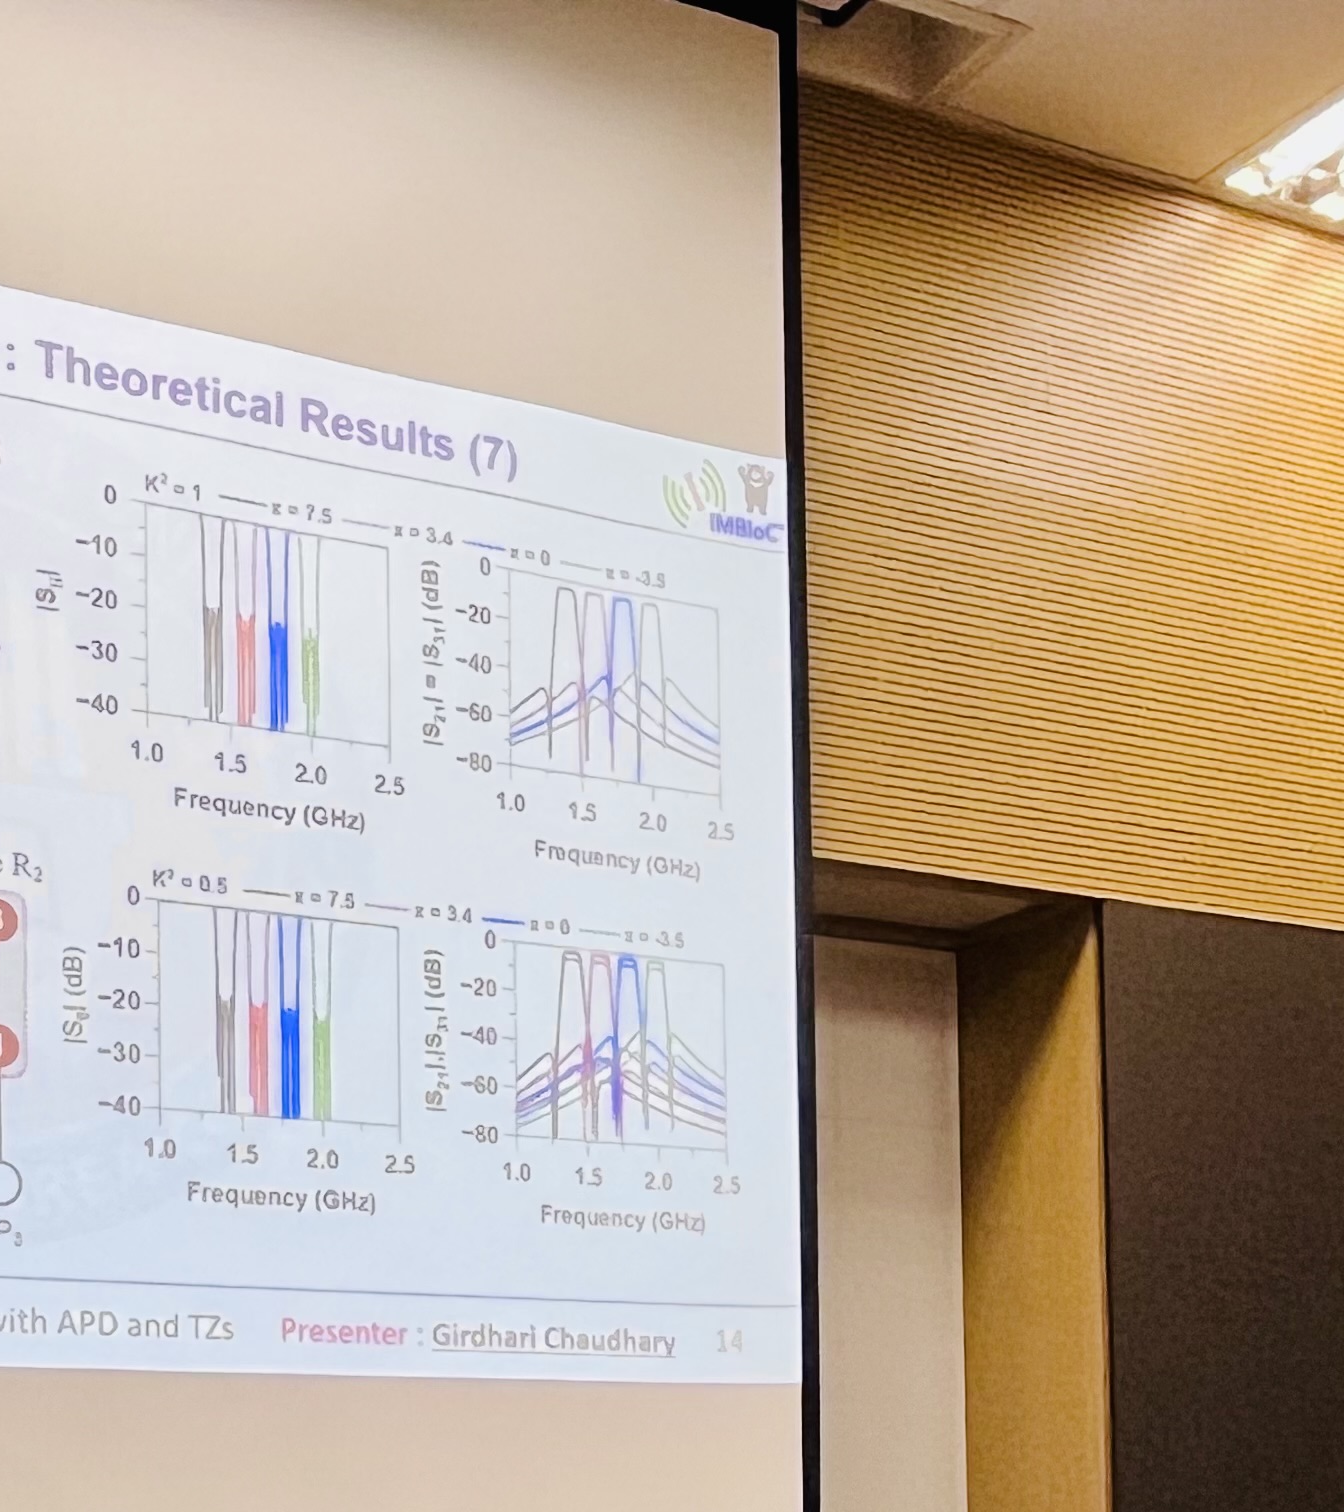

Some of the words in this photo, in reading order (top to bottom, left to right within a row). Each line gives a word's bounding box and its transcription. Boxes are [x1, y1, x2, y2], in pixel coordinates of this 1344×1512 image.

[5, 343, 17, 372] :
[35, 339, 284, 428] Theoretical
[300, 397, 455, 462] Results
[468, 432, 519, 483] (7)
[104, 485, 117, 504] 0
[480, 556, 491, 575] 0
[131, 739, 164, 763] 1.0
[214, 752, 247, 774] 1.5
[294, 763, 328, 786] 2.0
[374, 774, 405, 796] 2.5
[174, 787, 296, 826] Frequency
[303, 804, 366, 834] (GHz)
[496, 791, 526, 812] 1.0
[568, 802, 597, 823] 1.5
[639, 812, 667, 832] 2.0
[708, 821, 735, 842] 2.5
[534, 838, 641, 873] Frequency
[646, 855, 702, 882] (GHz)
[127, 886, 140, 904] 0
[484, 930, 496, 949] 0
[62, 946, 87, 997] (dB)
[423, 948, 446, 1001] (dB)
[144, 1138, 176, 1159] 1.0
[227, 1143, 259, 1165] 1.5
[307, 1149, 339, 1170] 2.0
[384, 1154, 416, 1175] 2.5
[503, 1162, 531, 1182] 1.0
[575, 1168, 602, 1187] 1.5
[644, 1172, 672, 1191] 2.0
[712, 1175, 741, 1195] 2.5
[187, 1181, 307, 1213] Frequency
[314, 1190, 376, 1216] (GHz)
[541, 1204, 646, 1233] Frequency
[652, 1211, 706, 1236] (GHz)
[57, 1309, 118, 1337] APD
[127, 1313, 179, 1340] and
[188, 1313, 234, 1342] TZs
[281, 1316, 408, 1346] Presenter
[416, 1327, 424, 1348] :
[432, 1321, 536, 1352] Girdhari
[544, 1327, 676, 1358] Chaudhary
[716, 1329, 743, 1354] 14
